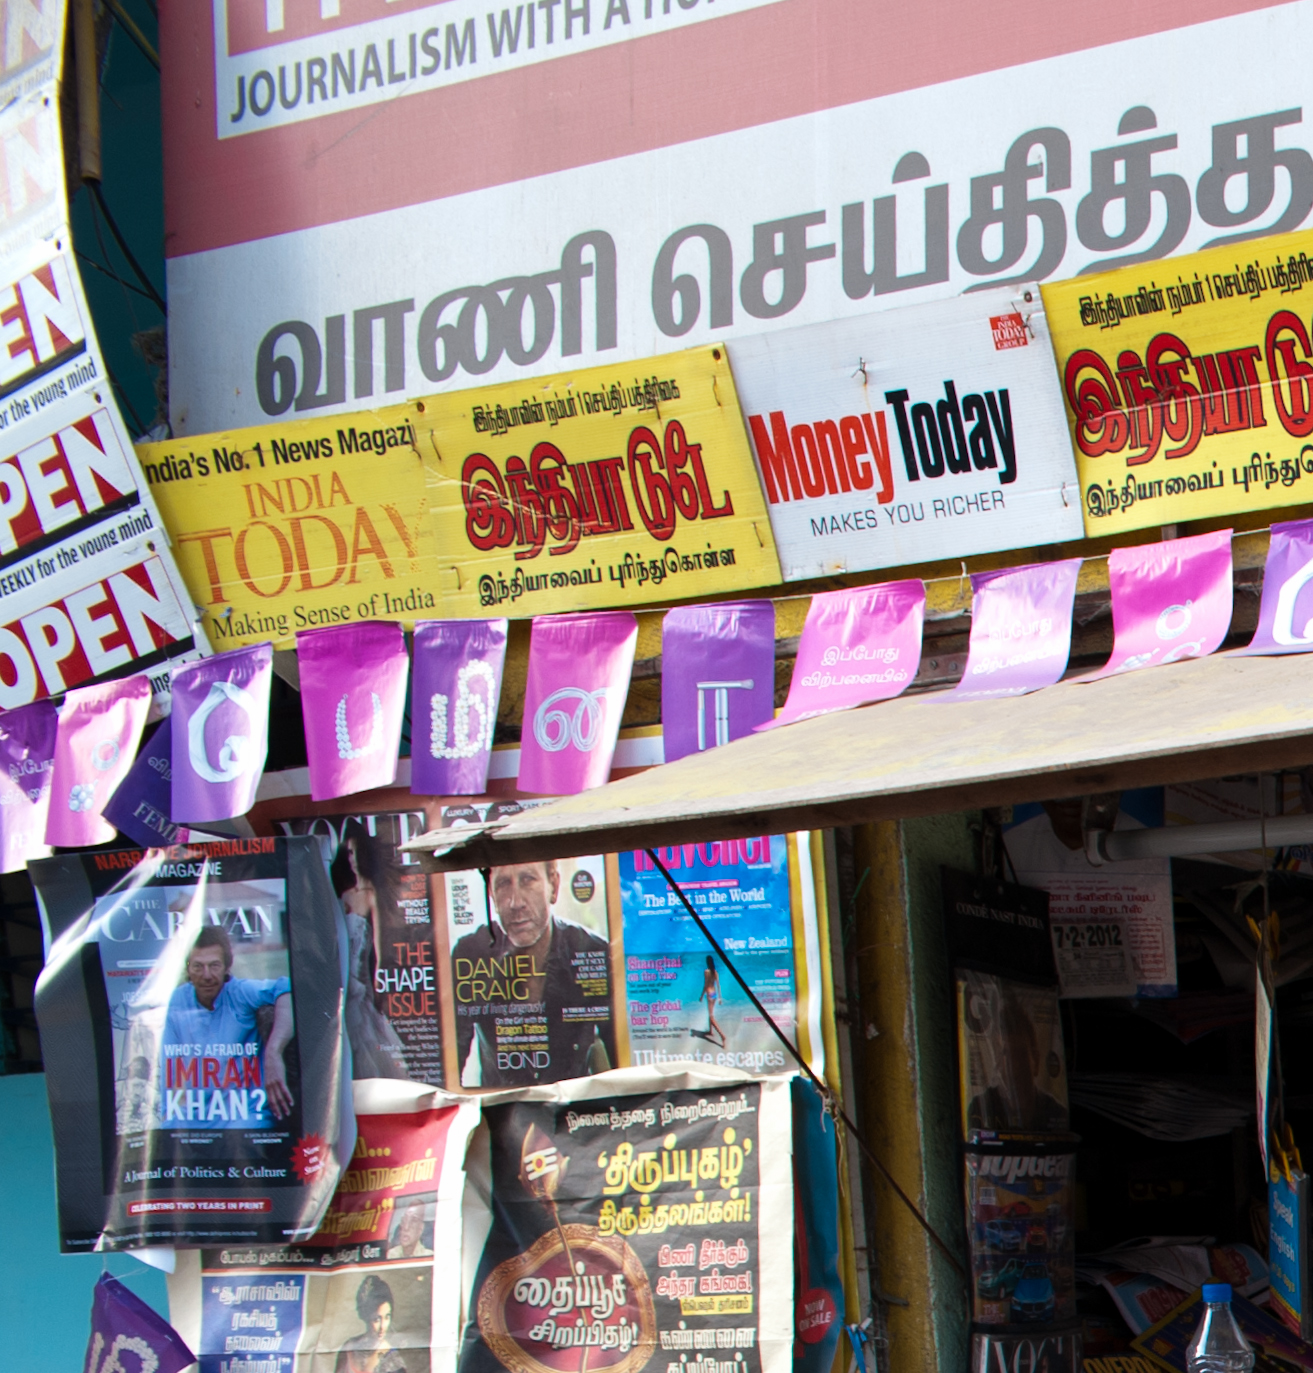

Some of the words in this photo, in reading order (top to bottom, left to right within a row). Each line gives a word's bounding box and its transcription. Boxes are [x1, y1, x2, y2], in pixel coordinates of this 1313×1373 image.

[230, 20, 478, 124] JOURNALISM
[489, 0, 592, 75] WITH
[255, 229, 619, 417] வாணி
[67, 356, 98, 389] mind
[1064, 331, 1267, 467] இந்தியா
[473, 402, 542, 437] இந்தியாவின்
[271, 433, 334, 464] News
[243, 471, 356, 517] INDIA
[460, 440, 626, 562] இந்தியா
[1086, 462, 1225, 519] இந்தியாவைப்
[811, 508, 882, 538] MAKES
[886, 503, 929, 528] YOU
[932, 489, 1006, 518] RICHER
[177, 500, 430, 605] TODAY
[478, 563, 603, 608] இந்தியாவைப்
[608, 545, 738, 594] புரிந்துகொள்ள
[212, 604, 291, 642] Making
[294, 600, 352, 631] Sense
[382, 588, 437, 617] India
[729, 886, 766, 902] World
[988, 907, 1016, 925] NAST
[1016, 911, 1047, 931] INDIA
[748, 935, 788, 949] Zealand
[375, 967, 435, 994] SHAPE
[455, 955, 546, 980] DANIEL
[456, 980, 530, 1003] CRAIG
[165, 1056, 261, 1089] IMRAN
[497, 1051, 550, 1070] BOND
[715, 1050, 785, 1073] escapes
[165, 1089, 267, 1121] KHAN?
[180, 1165, 225, 1179] Politics
[242, 1165, 286, 1178] Culture
